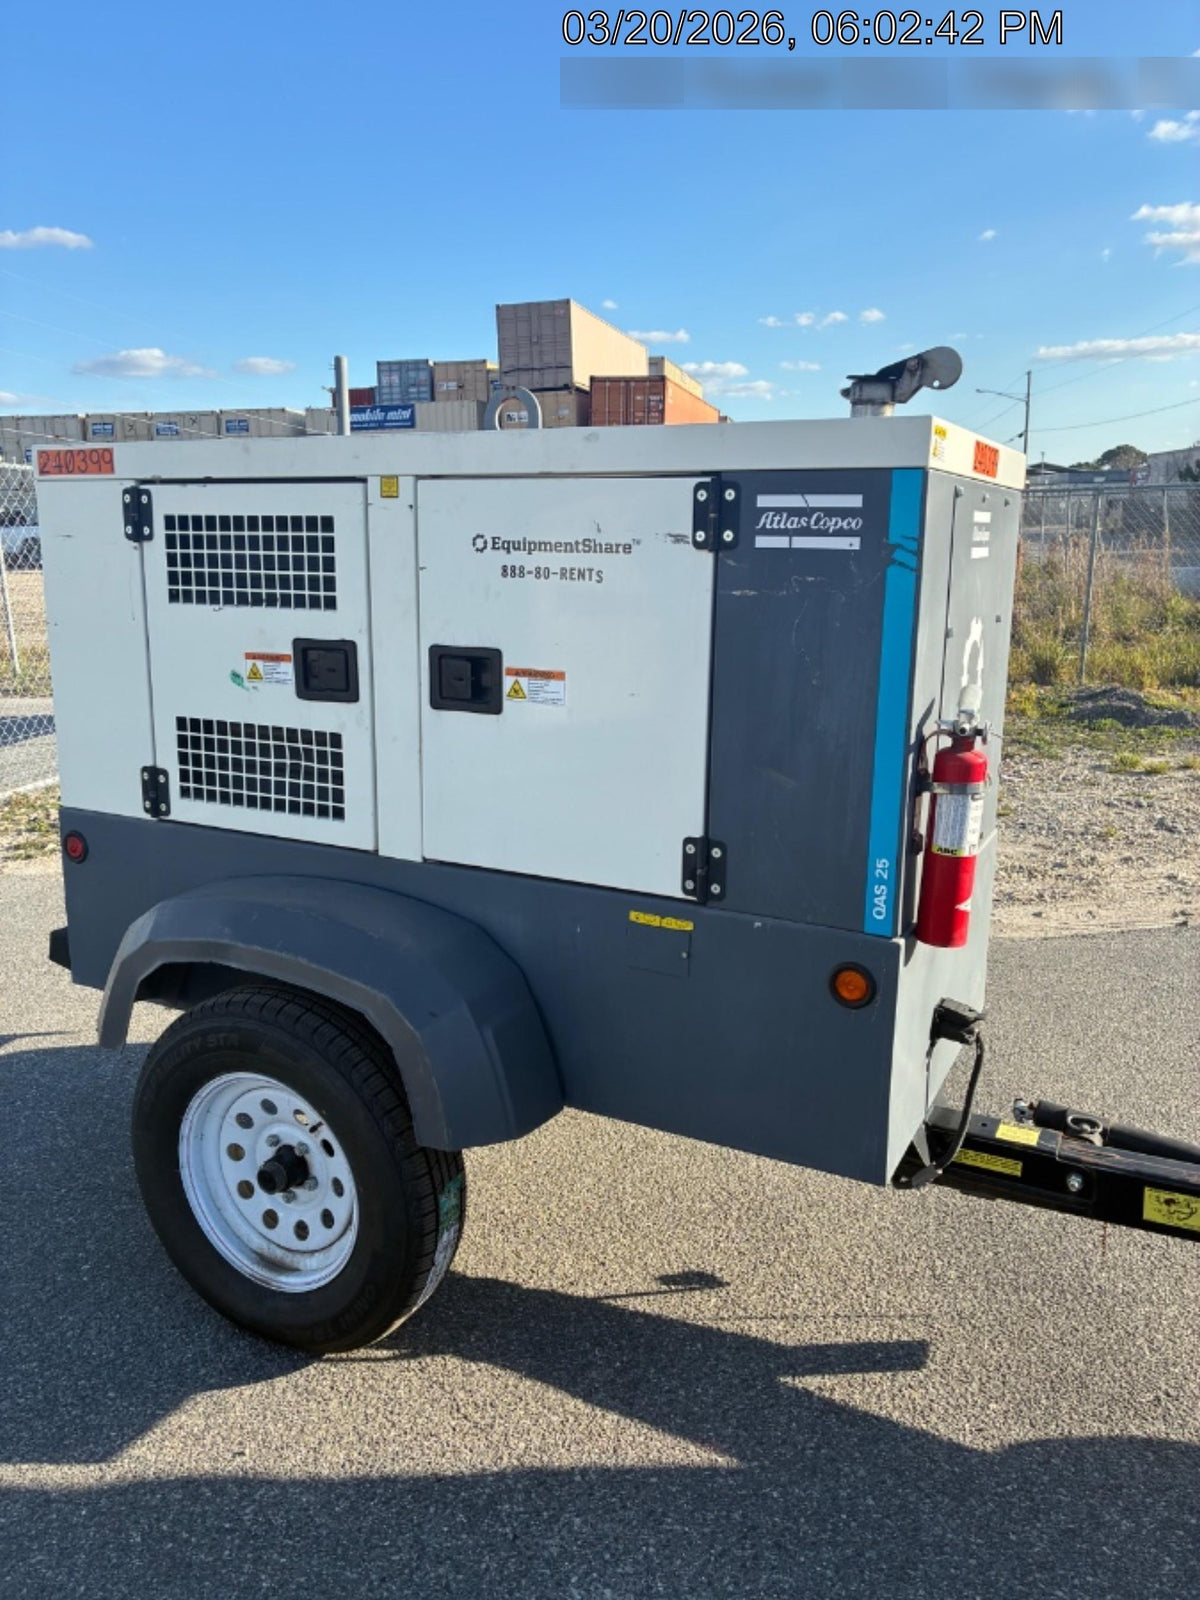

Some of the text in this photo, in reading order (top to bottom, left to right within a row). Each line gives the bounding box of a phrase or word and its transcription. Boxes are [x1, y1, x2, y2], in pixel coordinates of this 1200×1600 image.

[39, 448, 115, 474] 240399
[756, 511, 863, 533] Atlas Copco
[500, 564, 604, 584] 888-80-RENTS
[873, 858, 890, 920] QAS 25
